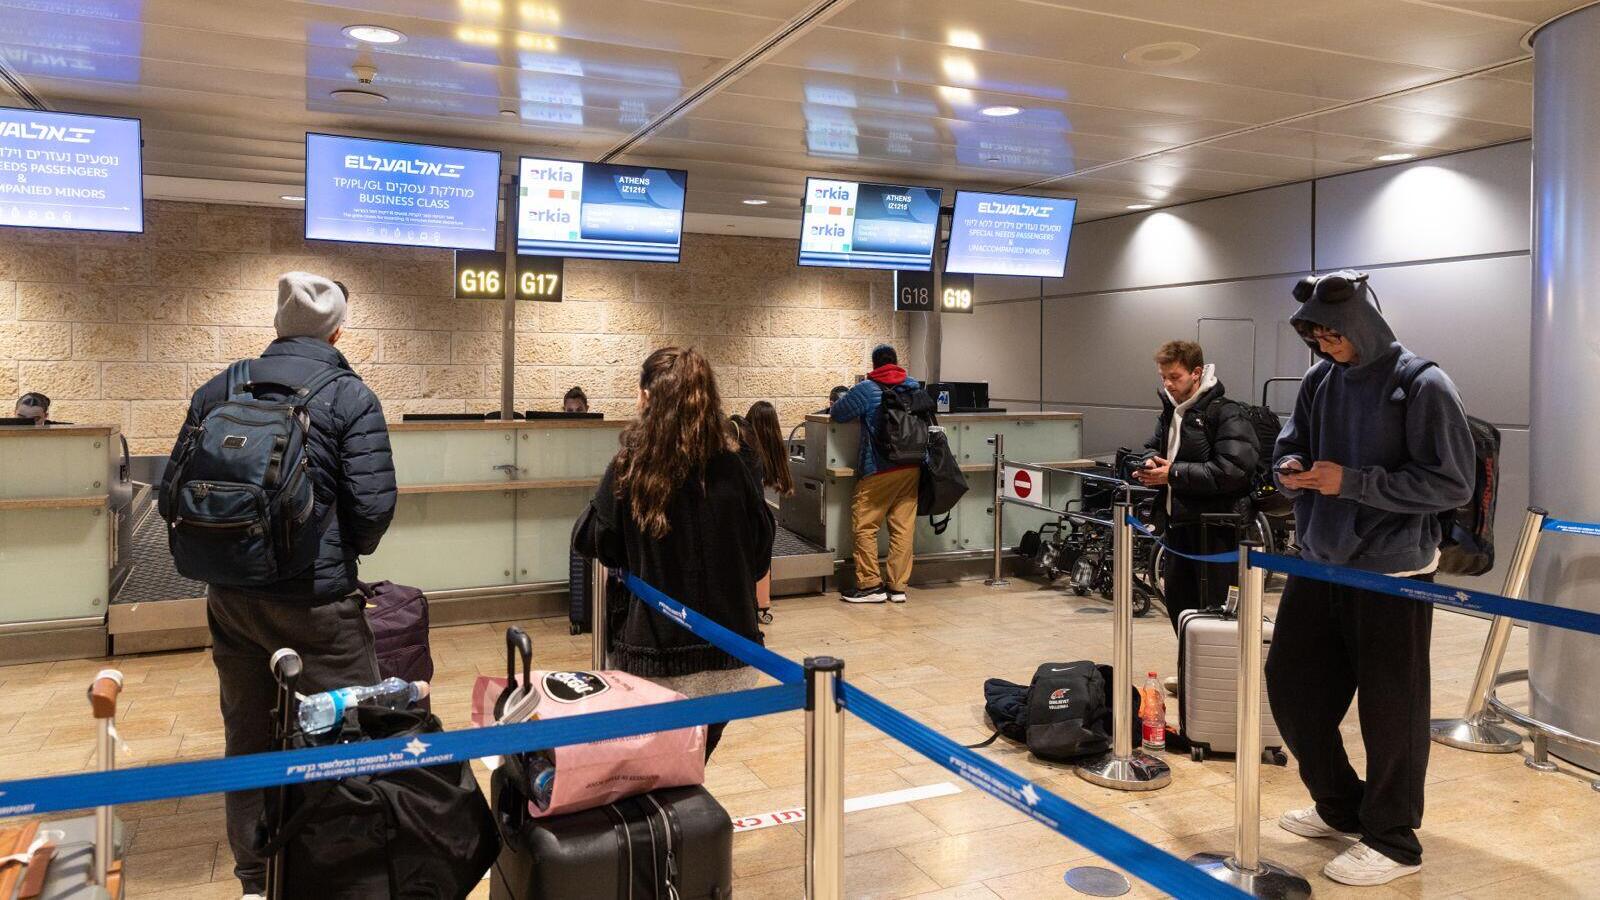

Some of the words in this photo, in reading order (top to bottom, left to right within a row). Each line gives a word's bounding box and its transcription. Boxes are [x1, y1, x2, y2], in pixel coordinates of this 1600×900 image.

[17, 173, 26, 183] &
[31, 164, 108, 178] PASSENGERS
[333, 177, 382, 191] TP/PL/GL
[386, 181, 426, 195] עסקים
[619, 176, 650, 186] ATHENS
[55, 187, 106, 199] MINORS
[430, 185, 474, 199] מחלקת
[886, 194, 912, 203] ATHENS
[359, 193, 414, 207] BUSINESS
[416, 198, 450, 209] CLASS
[969, 229, 994, 238] SPECIAL
[1016, 232, 1055, 241] PASSENGERS
[461, 269, 500, 293] G16
[521, 272, 558, 295] G17
[901, 287, 929, 305] G18
[943, 288, 972, 309] G19
[303, 766, 356, 780] BEN-GURION
[357, 759, 419, 772] INTERNATIONAL
[420, 753, 454, 764] AIRPORT
